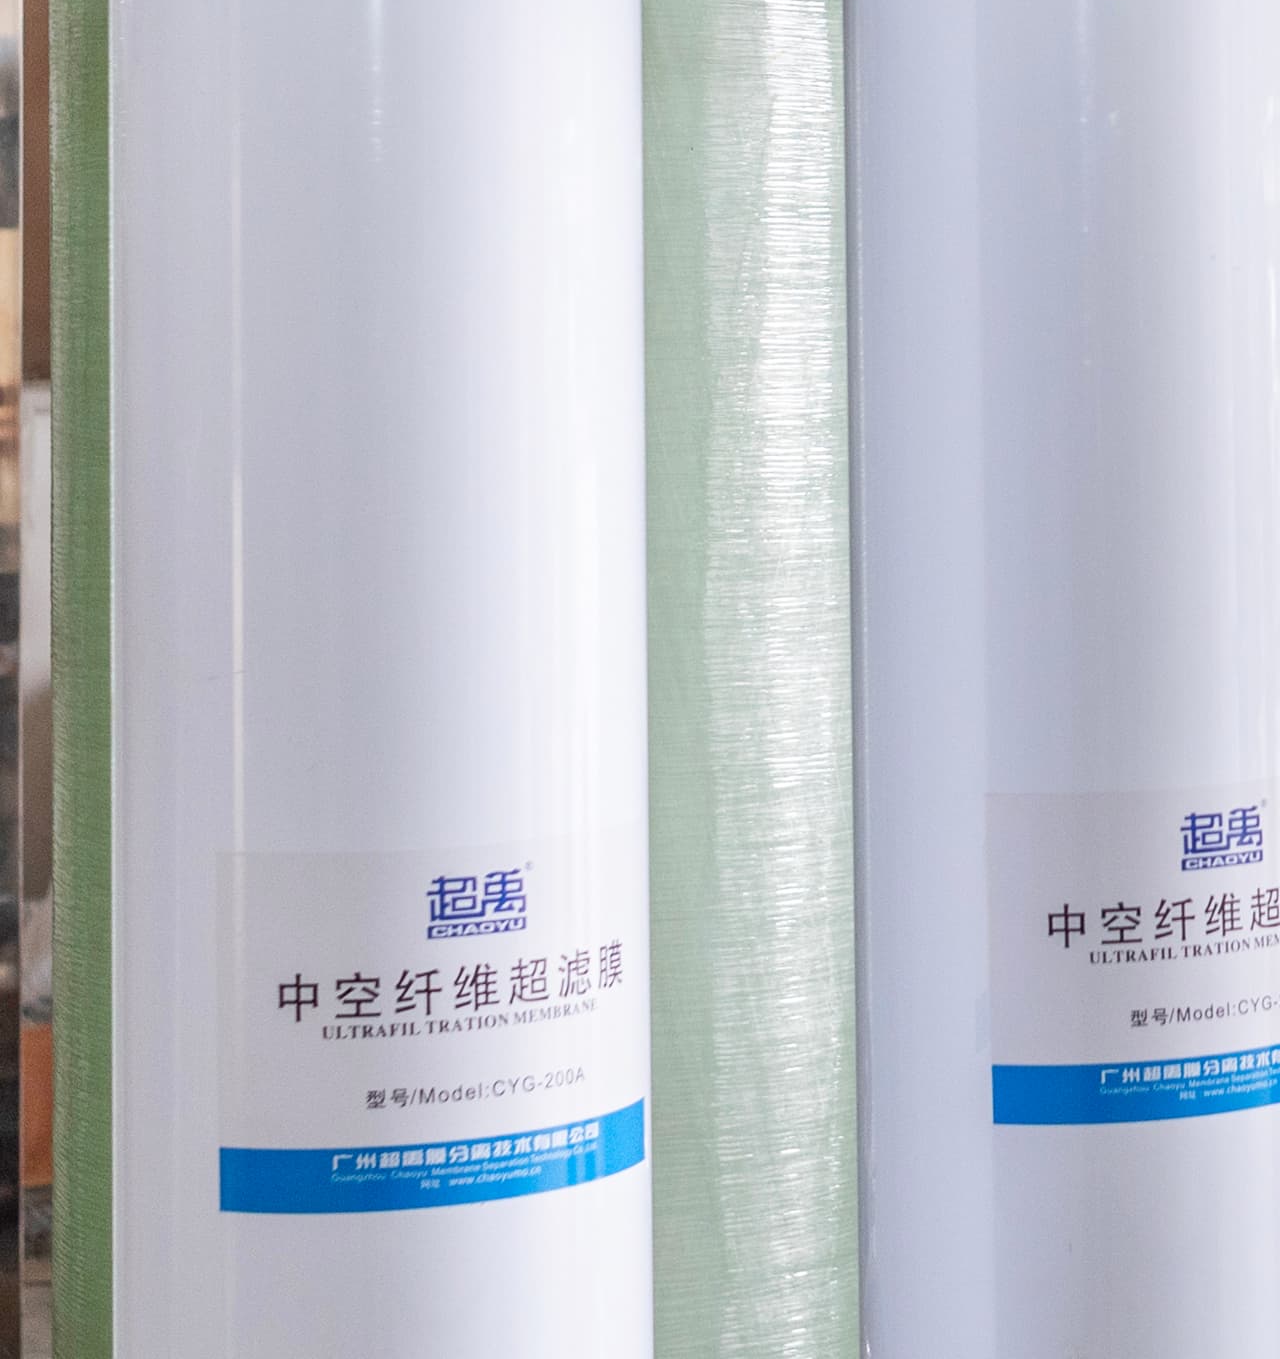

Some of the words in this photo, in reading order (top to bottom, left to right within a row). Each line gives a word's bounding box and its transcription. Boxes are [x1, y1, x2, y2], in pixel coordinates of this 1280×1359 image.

[1184, 850, 1262, 870] CHAOYU
[431, 917, 525, 939] CHAOYU
[277, 939, 624, 1023] 中空纤维超滤膜
[513, 998, 598, 1025] MEMBRANE
